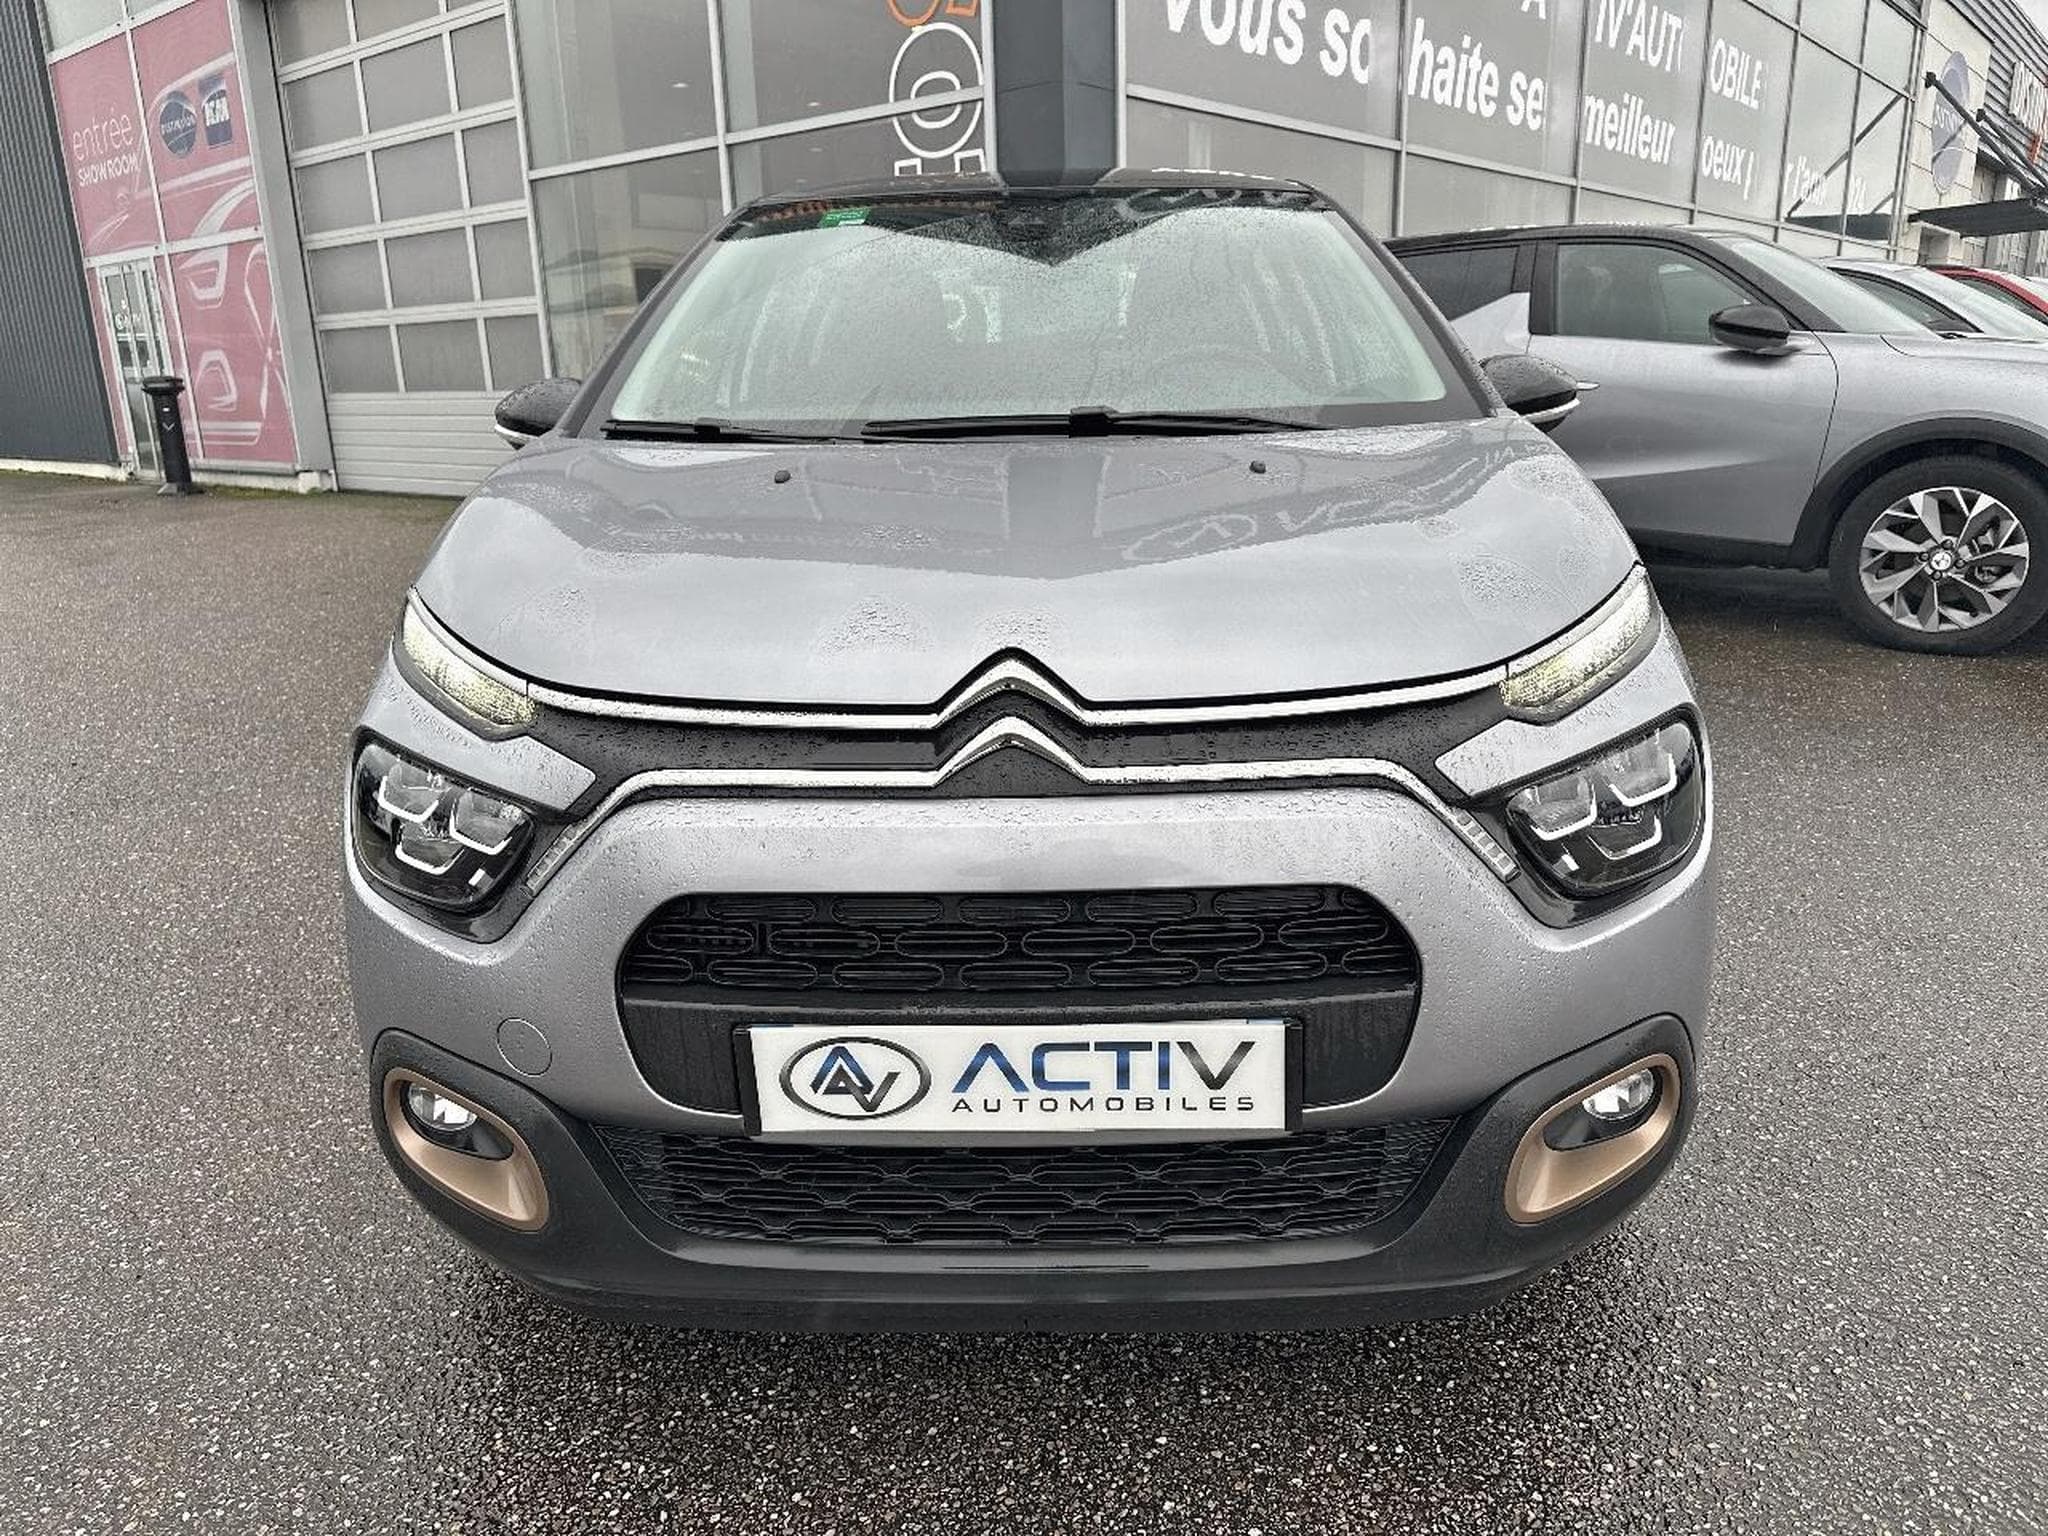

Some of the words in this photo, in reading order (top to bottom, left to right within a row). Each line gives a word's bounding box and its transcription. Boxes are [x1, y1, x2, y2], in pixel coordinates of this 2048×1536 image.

[1595, 0, 1686, 72] IV'AUT
[1408, 17, 1500, 118] haite
[1506, 71, 1549, 131] se
[1584, 92, 1675, 165] meilleur
[73, 107, 134, 161] entrée
[79, 153, 141, 187] SHOWROOM
[952, 1041, 1256, 1093] ACTIV
[952, 1097, 1254, 1113] AUTOMOBILES
